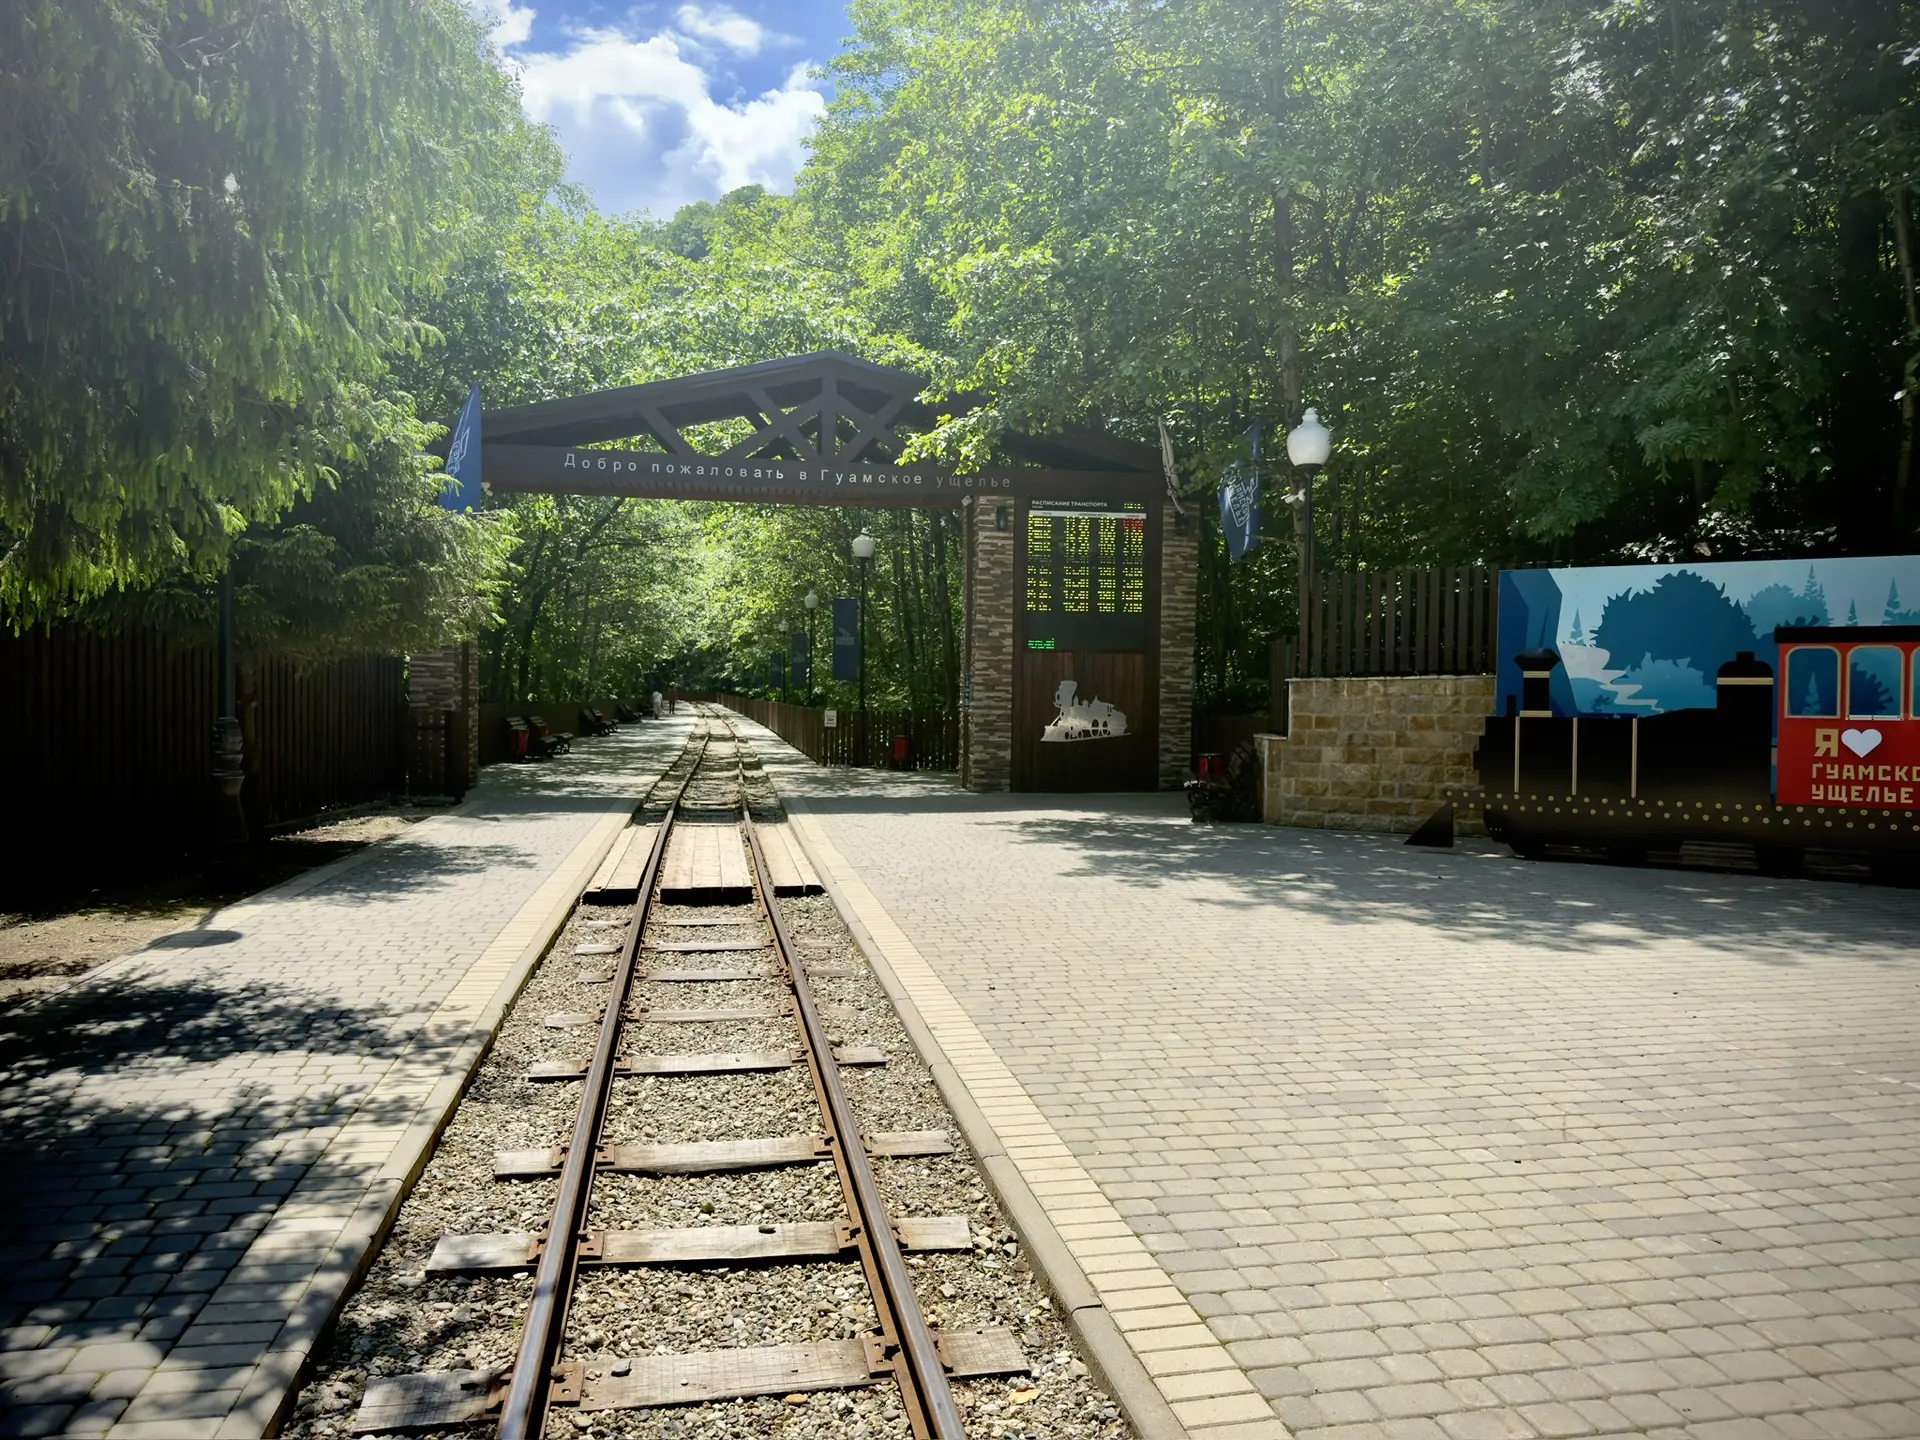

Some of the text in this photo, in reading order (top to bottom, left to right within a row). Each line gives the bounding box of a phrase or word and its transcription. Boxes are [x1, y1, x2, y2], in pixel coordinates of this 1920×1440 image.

[564, 453, 1011, 488] Добро пожаловать в Гуамское ущелье
[1813, 728, 1839, 758] Я
[1811, 784, 1914, 804] УЩЕЛЬЕ
